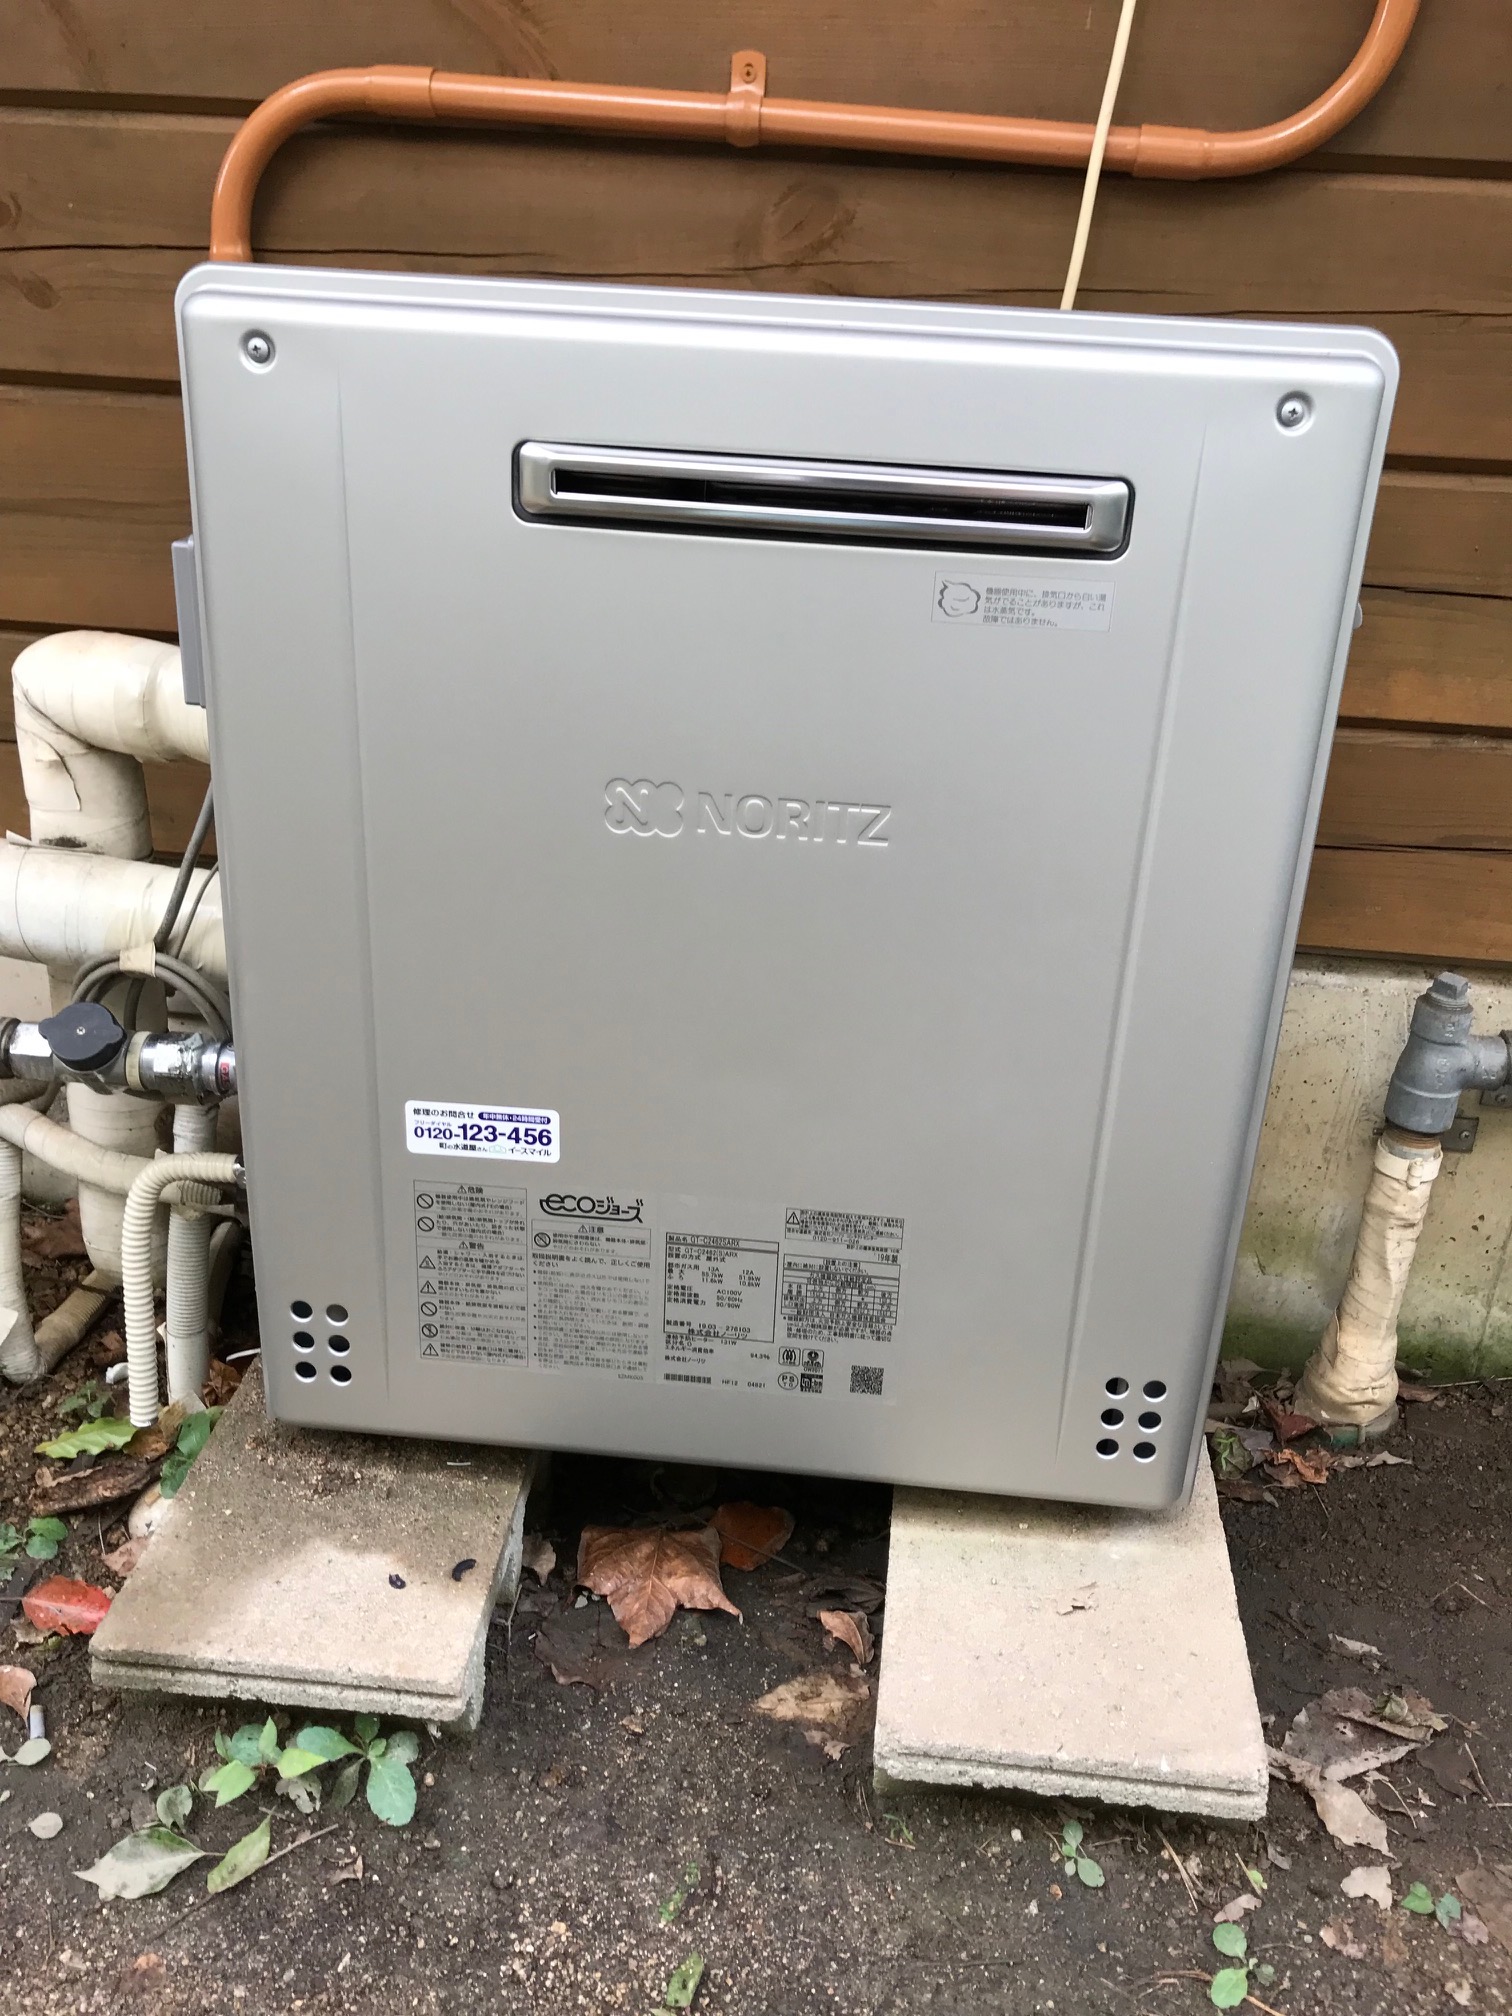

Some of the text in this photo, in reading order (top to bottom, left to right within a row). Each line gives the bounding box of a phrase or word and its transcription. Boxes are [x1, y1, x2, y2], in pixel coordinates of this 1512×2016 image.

[984, 606, 1035, 616] は水蒸気です。
[983, 615, 1058, 627] 故障ではありません。
[697, 791, 892, 847] NORITZ
[413, 1107, 474, 1119] 修理のお問合せ
[414, 1119, 452, 1127] フリーダイヤル
[414, 1123, 552, 1147] 0120-123-456
[439, 1142, 552, 1157] 町の水道屋さん イースマイル
[467, 1186, 483, 1194] 危険
[588, 1225, 603, 1233] 注意
[469, 1241, 484, 1249] 警告
[668, 1252, 701, 1261] 設置の方式
[667, 1262, 699, 1270] 都市ガス用
[667, 1283, 742, 1296] 定格電圧 AC100V
[667, 1289, 699, 1298] 定格周波数
[666, 1296, 705, 1306] 定格消費電力
[687, 1326, 747, 1341] 株式会社ノーリツ
[664, 1353, 705, 1365] 株式会社ノーリツ
